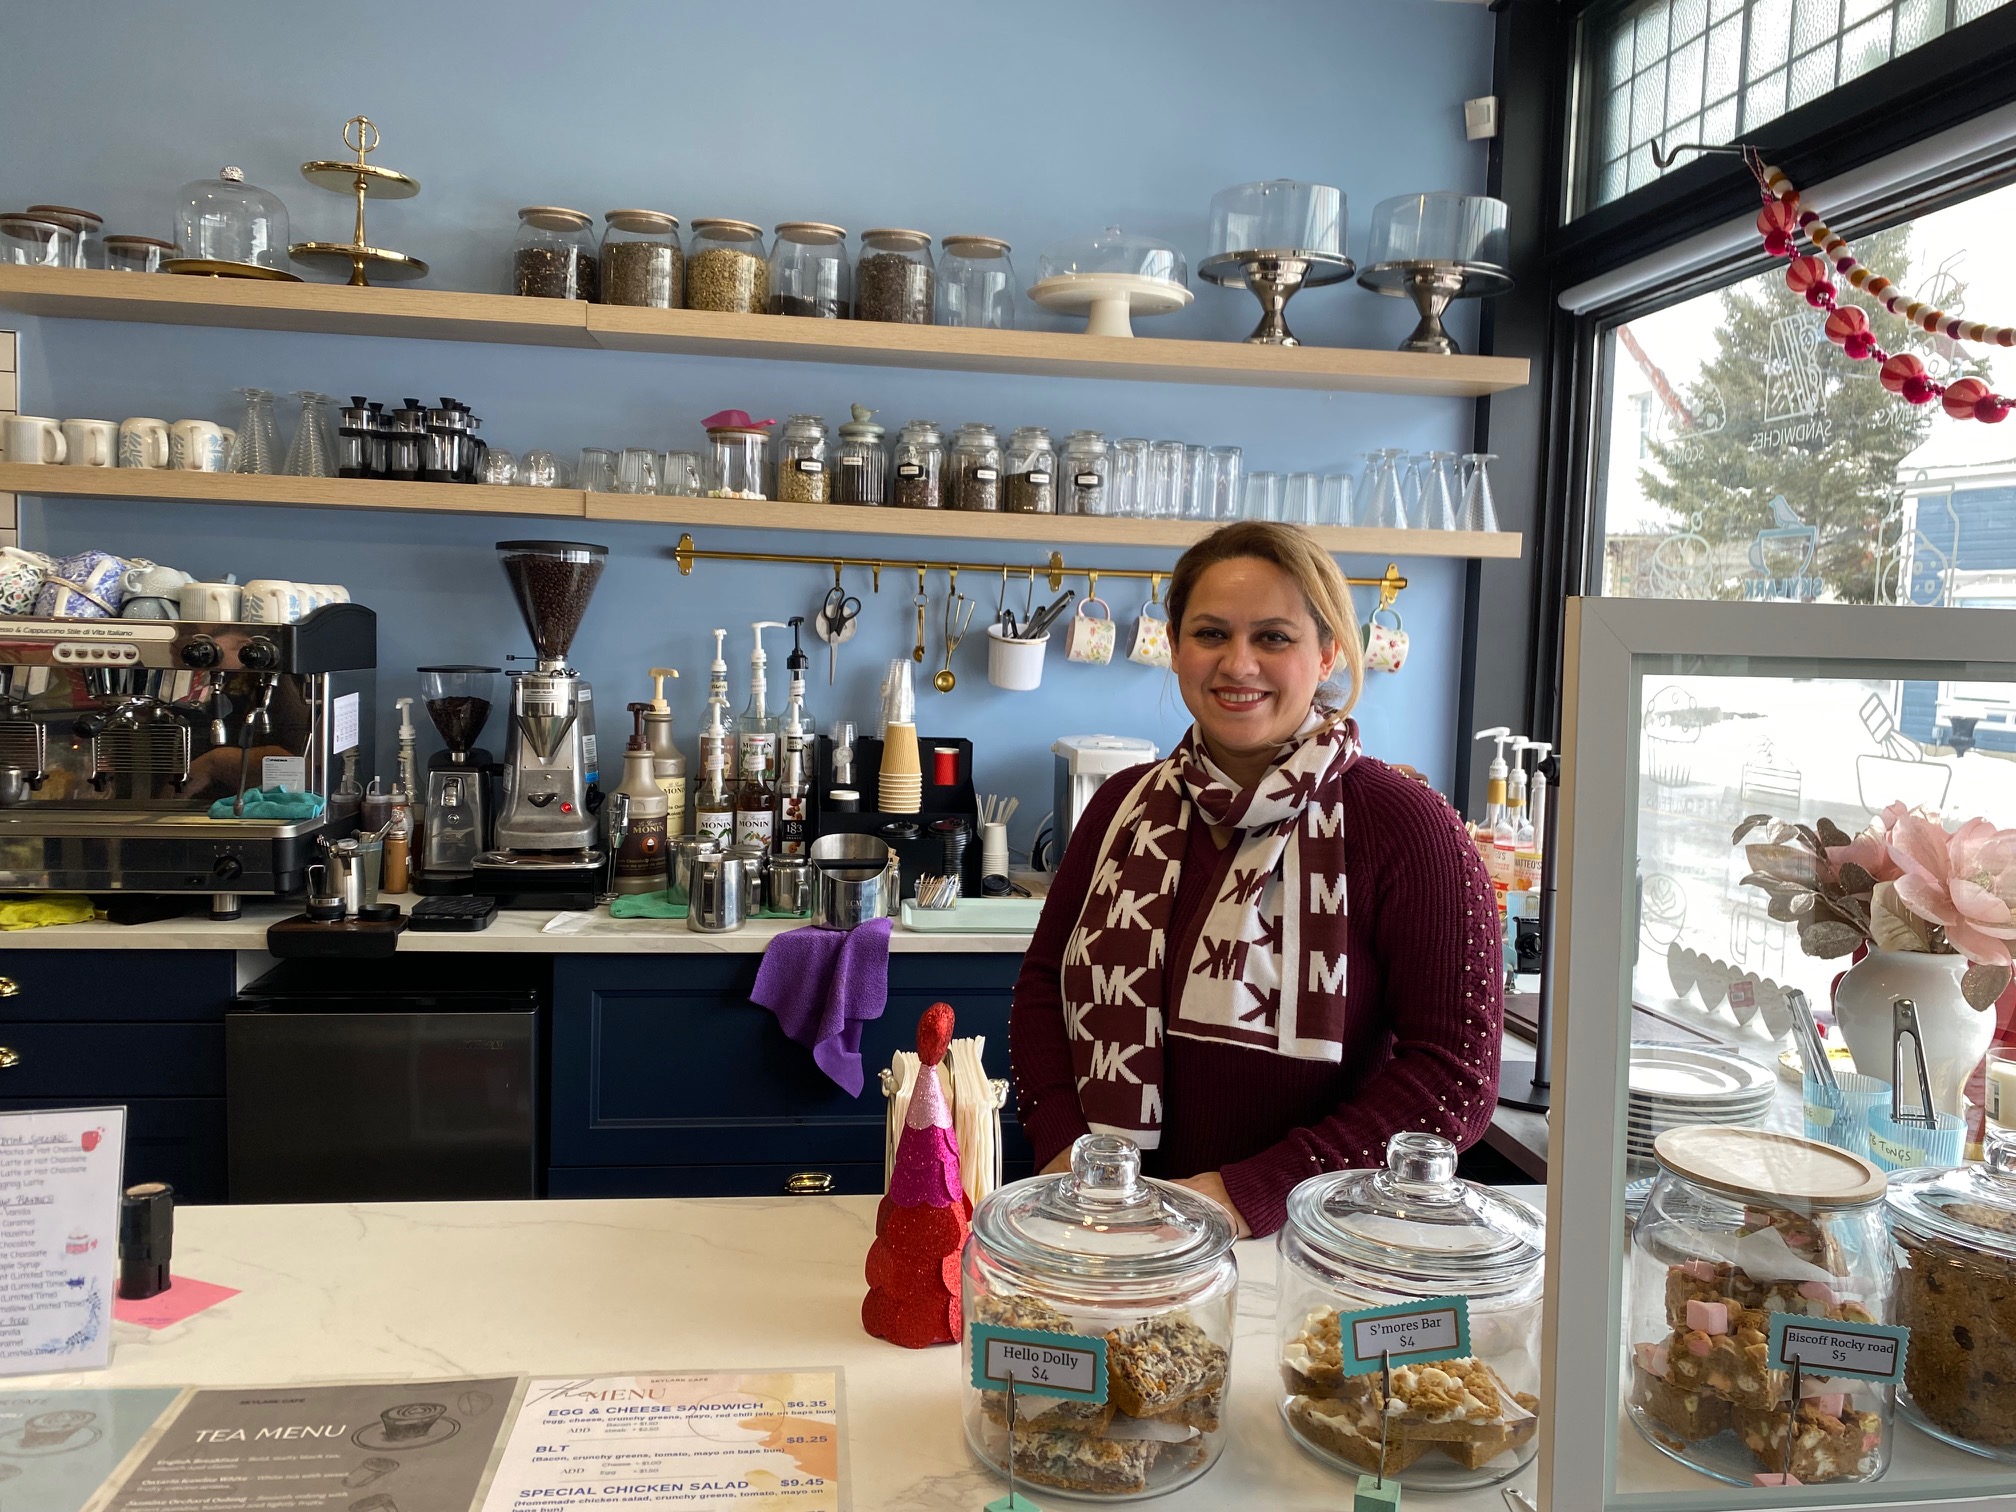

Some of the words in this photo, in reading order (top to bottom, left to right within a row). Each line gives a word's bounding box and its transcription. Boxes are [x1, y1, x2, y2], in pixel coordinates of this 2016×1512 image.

[23, 627, 65, 635] Cappuccino
[633, 825, 664, 834] MONIN
[701, 821, 732, 829] MONIN
[739, 820, 769, 828] MONIN
[1421, 1318, 1442, 1329] Bar
[1399, 1335, 1416, 1348] $4
[1788, 1332, 1829, 1346] Biscoff
[1830, 1337, 1865, 1352] Rocky
[1867, 1343, 1894, 1354] road
[1003, 1346, 1039, 1362] Hello
[1042, 1351, 1079, 1370] Dolly
[1832, 1350, 1847, 1362] $5
[1031, 1366, 1049, 1382] $4
[585, 1387, 667, 1403] MENU
[548, 1409, 584, 1417] EGG
[605, 1405, 672, 1414] CHEESE
[677, 1402, 764, 1412] SANDWICH
[786, 1400, 828, 1409] $6.35
[648, 1414, 683, 1422] greens,
[195, 1428, 246, 1443] TEA
[254, 1424, 347, 1441] MENU
[786, 1435, 828, 1444] $8.25
[535, 1445, 570, 1453] BLT
[532, 1455, 570, 1463] (Bacon,
[519, 1487, 597, 1498] SPECIAL
[603, 1483, 683, 1494] CHICKEN
[689, 1481, 749, 1491] SALAD
[780, 1478, 825, 1487] $9.45
[514, 1498, 576, 1507] (Homemade
